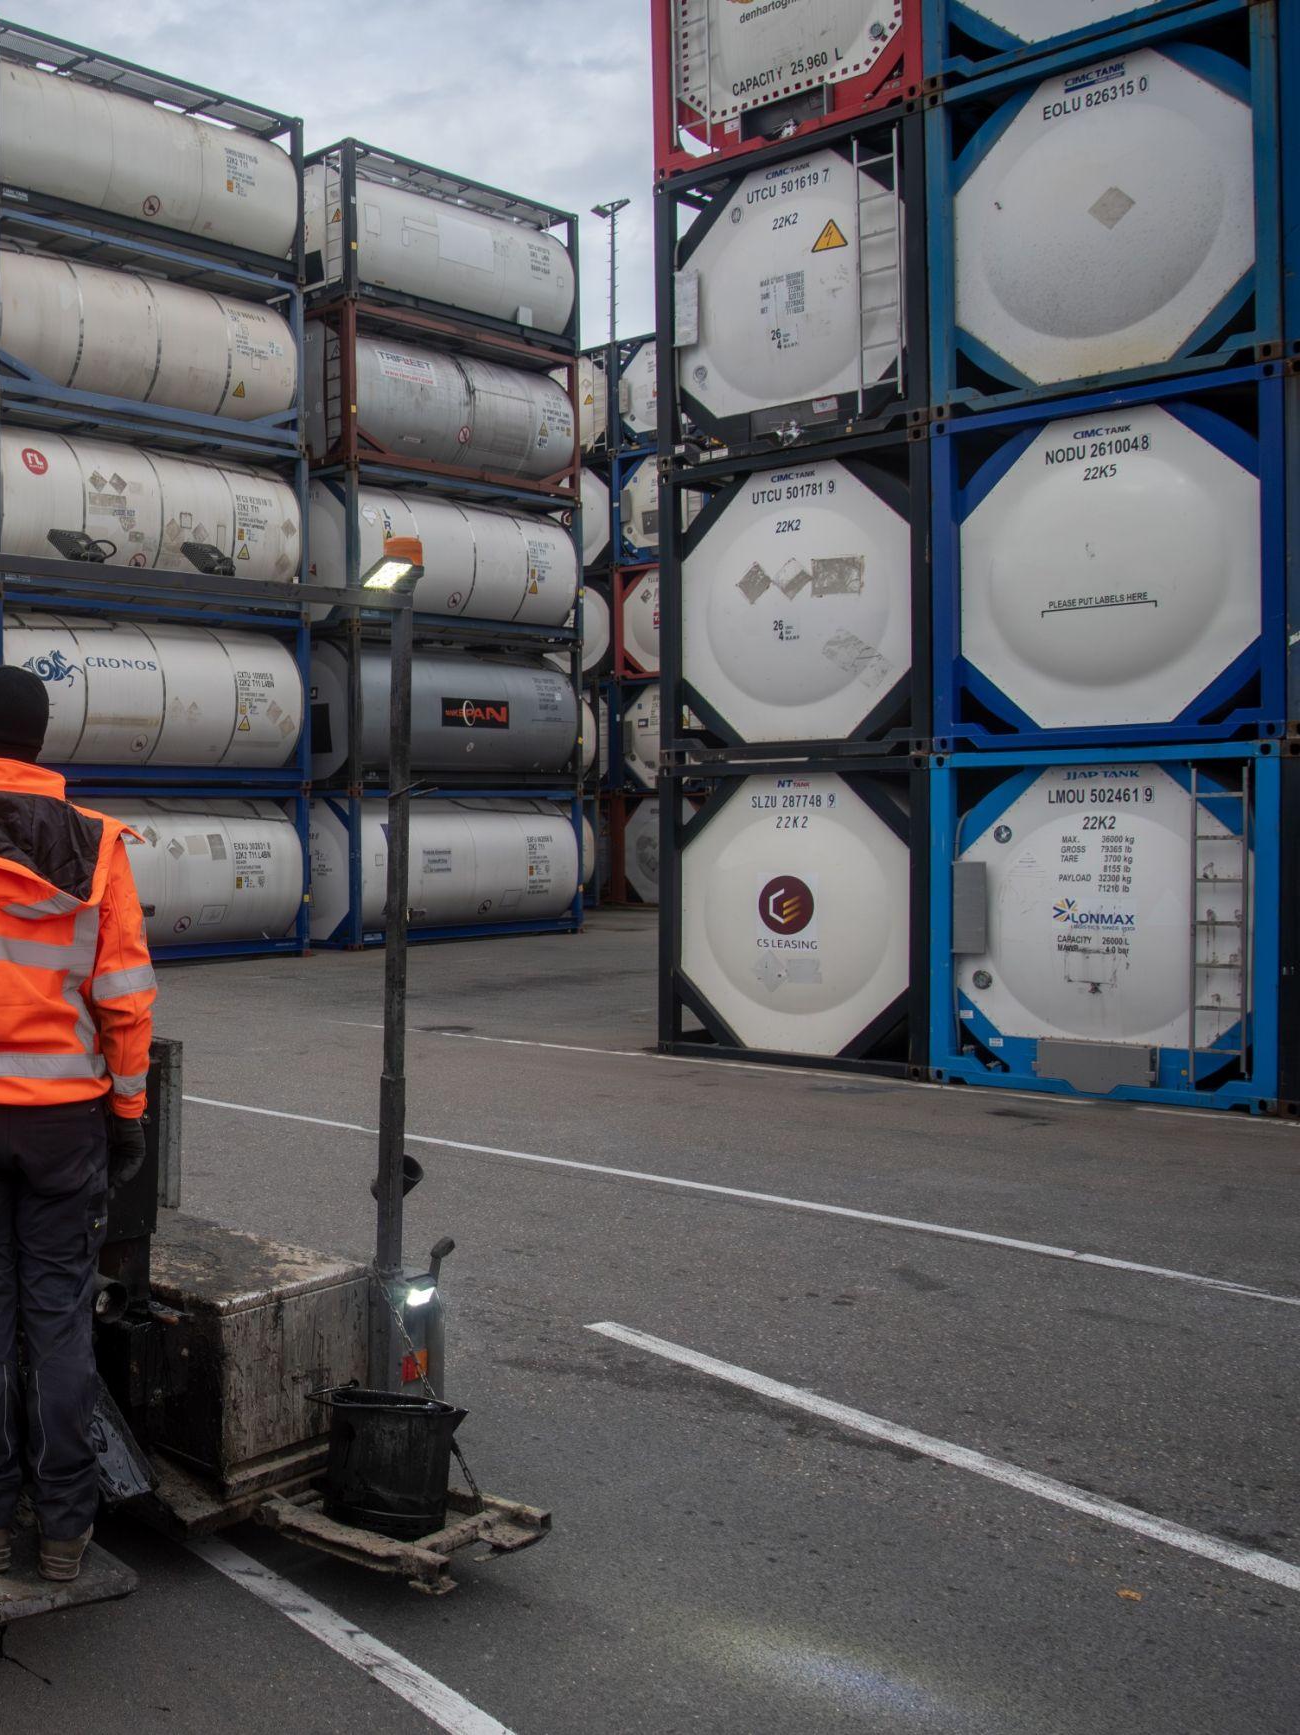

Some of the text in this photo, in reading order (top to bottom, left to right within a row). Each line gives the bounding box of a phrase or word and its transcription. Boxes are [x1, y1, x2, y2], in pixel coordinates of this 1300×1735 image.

[733, 47, 844, 96] CAPACITY 25,960 L
[1094, 62, 1125, 78] TANK
[1043, 77, 1148, 120] EOLU 826315 0
[765, 161, 811, 180] CIMC TANK
[746, 168, 830, 204] UTCU 501619 7
[772, 213, 798, 231] 22K2
[770, 328, 781, 341] 26
[1073, 425, 1131, 439] CIMC TANK
[1045, 445, 1086, 465] NODU
[1090, 437, 1139, 458] 261004
[771, 470, 815, 483] CIMC TANK
[1083, 464, 1117, 481] 22K5
[752, 479, 835, 505] UTCU 501781 9
[775, 519, 801, 534] 22K2
[1049, 592, 1148, 609] PLEASE PUT LABELS HERE
[773, 620, 784, 631] 26
[85, 656, 157, 671] CRONOS
[1100, 769, 1140, 778] TANK
[777, 780, 793, 788] NT
[751, 794, 835, 808] SLZU 287748 9
[1048, 787, 1153, 804] LMOU 502461 9
[1082, 816, 1116, 830] 22K2
[1101, 835, 1123, 843] 36000
[1125, 835, 1135, 845] kg
[1061, 855, 1078, 863] TARE
[1123, 855, 1133, 864] kg
[1058, 873, 1092, 882] PAYLOAD
[1122, 875, 1132, 884] kg
[1071, 913, 1134, 925] LONMAX
[757, 938, 818, 950] CS LEASING
[1057, 935, 1092, 944] CAPACITY
